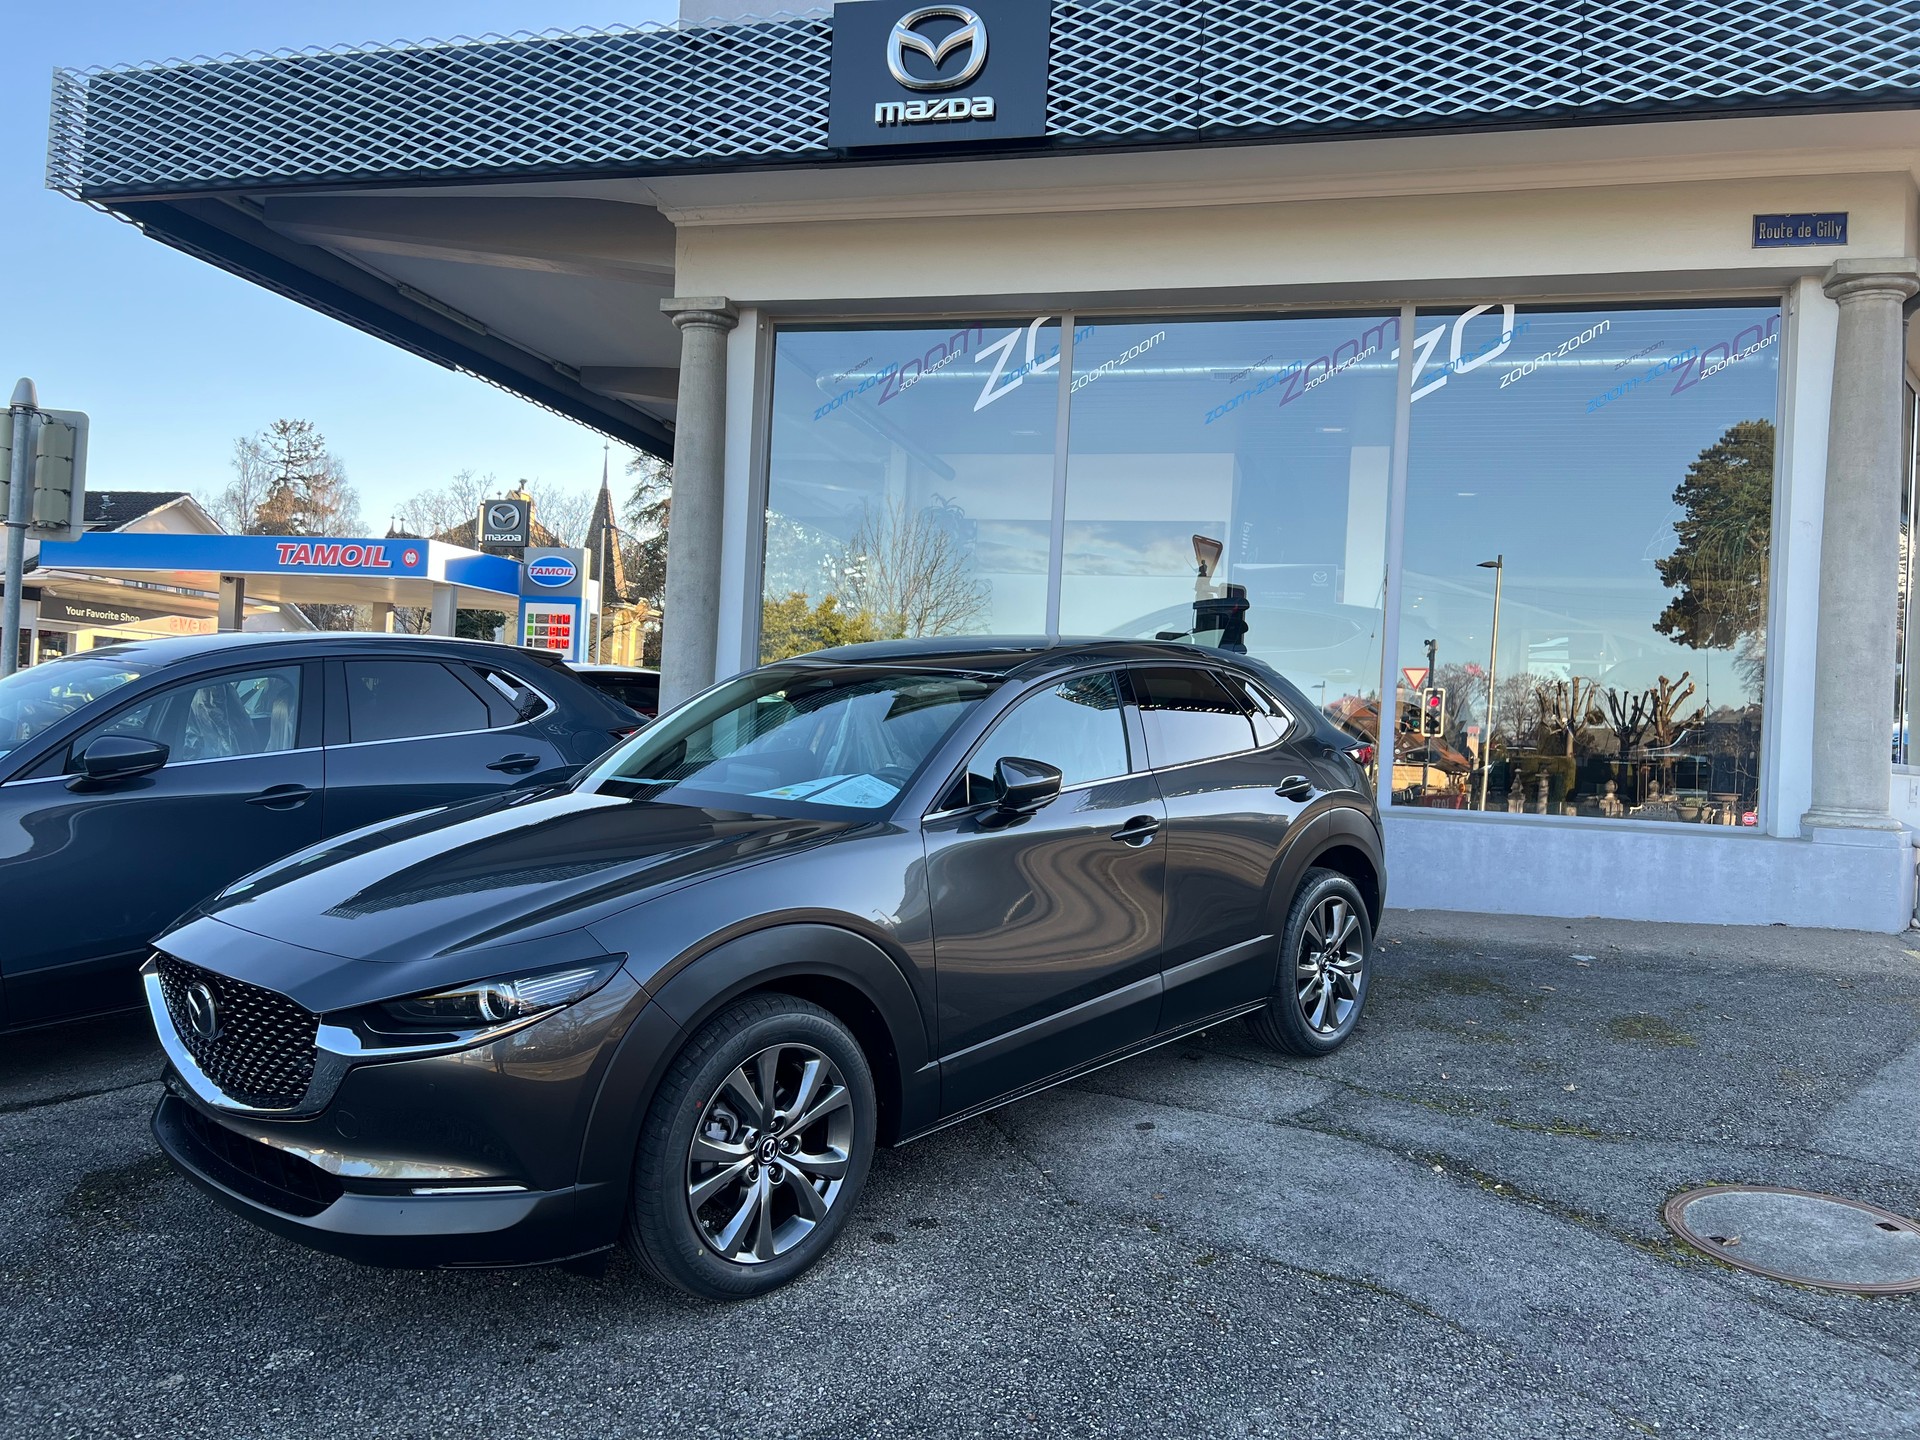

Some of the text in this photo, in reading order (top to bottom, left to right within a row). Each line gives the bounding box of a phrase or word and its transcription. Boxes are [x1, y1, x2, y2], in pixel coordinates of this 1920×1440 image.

[1759, 220, 1842, 240] Route de Gilly
[899, 348, 961, 392] zoom-zoom
[1070, 330, 1166, 393] zoom-zoom
[1304, 345, 1376, 393] zoom-zoom
[1500, 319, 1610, 389] zoom-zoom
[814, 361, 898, 421] zoom-zoom
[1204, 359, 1303, 425] zoom-zoom
[1585, 344, 1698, 414] zoom-zoom
[276, 542, 392, 568] TAMOIL
[529, 567, 574, 576] TAMOIL
[65, 605, 85, 617] Your
[86, 609, 119, 621] Favorite
[169, 616, 210, 633] avec
